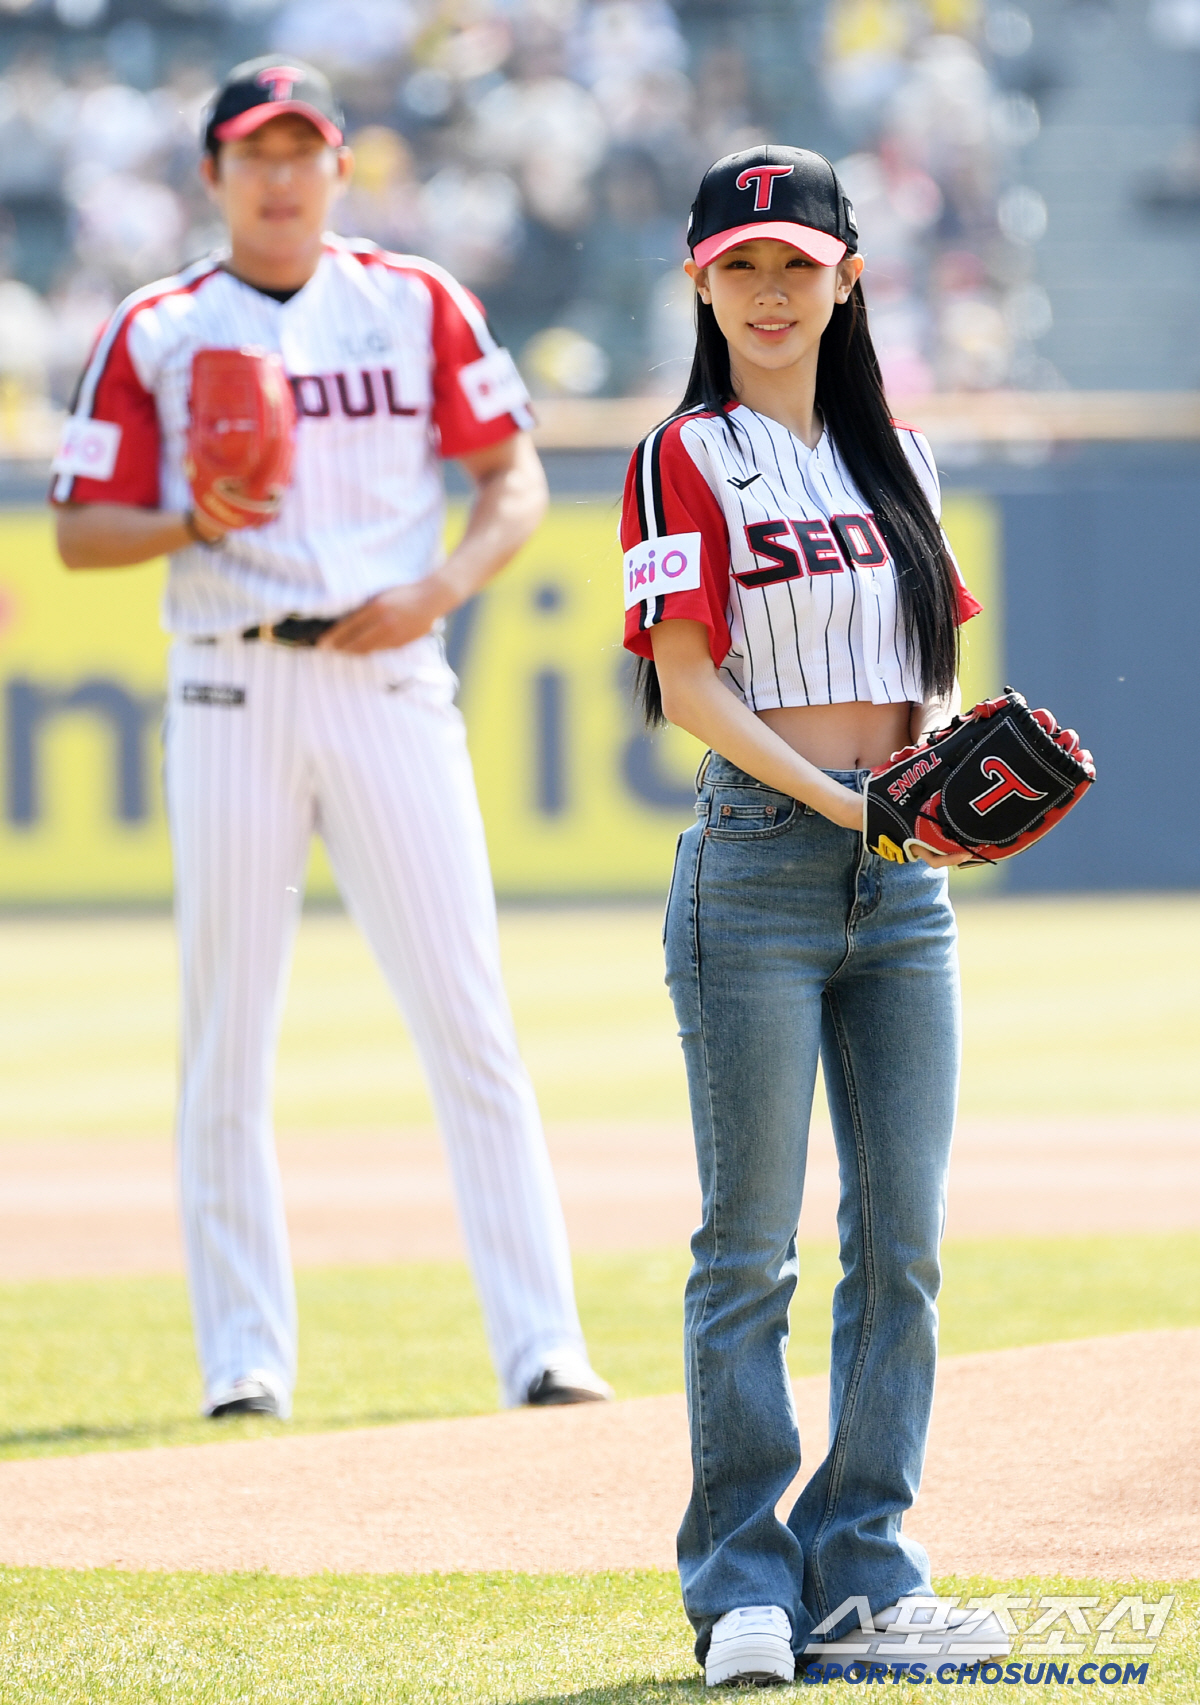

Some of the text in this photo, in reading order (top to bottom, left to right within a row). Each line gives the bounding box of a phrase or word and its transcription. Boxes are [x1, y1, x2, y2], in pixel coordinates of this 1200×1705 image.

[736, 164, 794, 212] T
[289, 368, 418, 418] OUL
[731, 513, 888, 590] SEO
[887, 751, 943, 802] TWINS
[968, 755, 1049, 817] T
